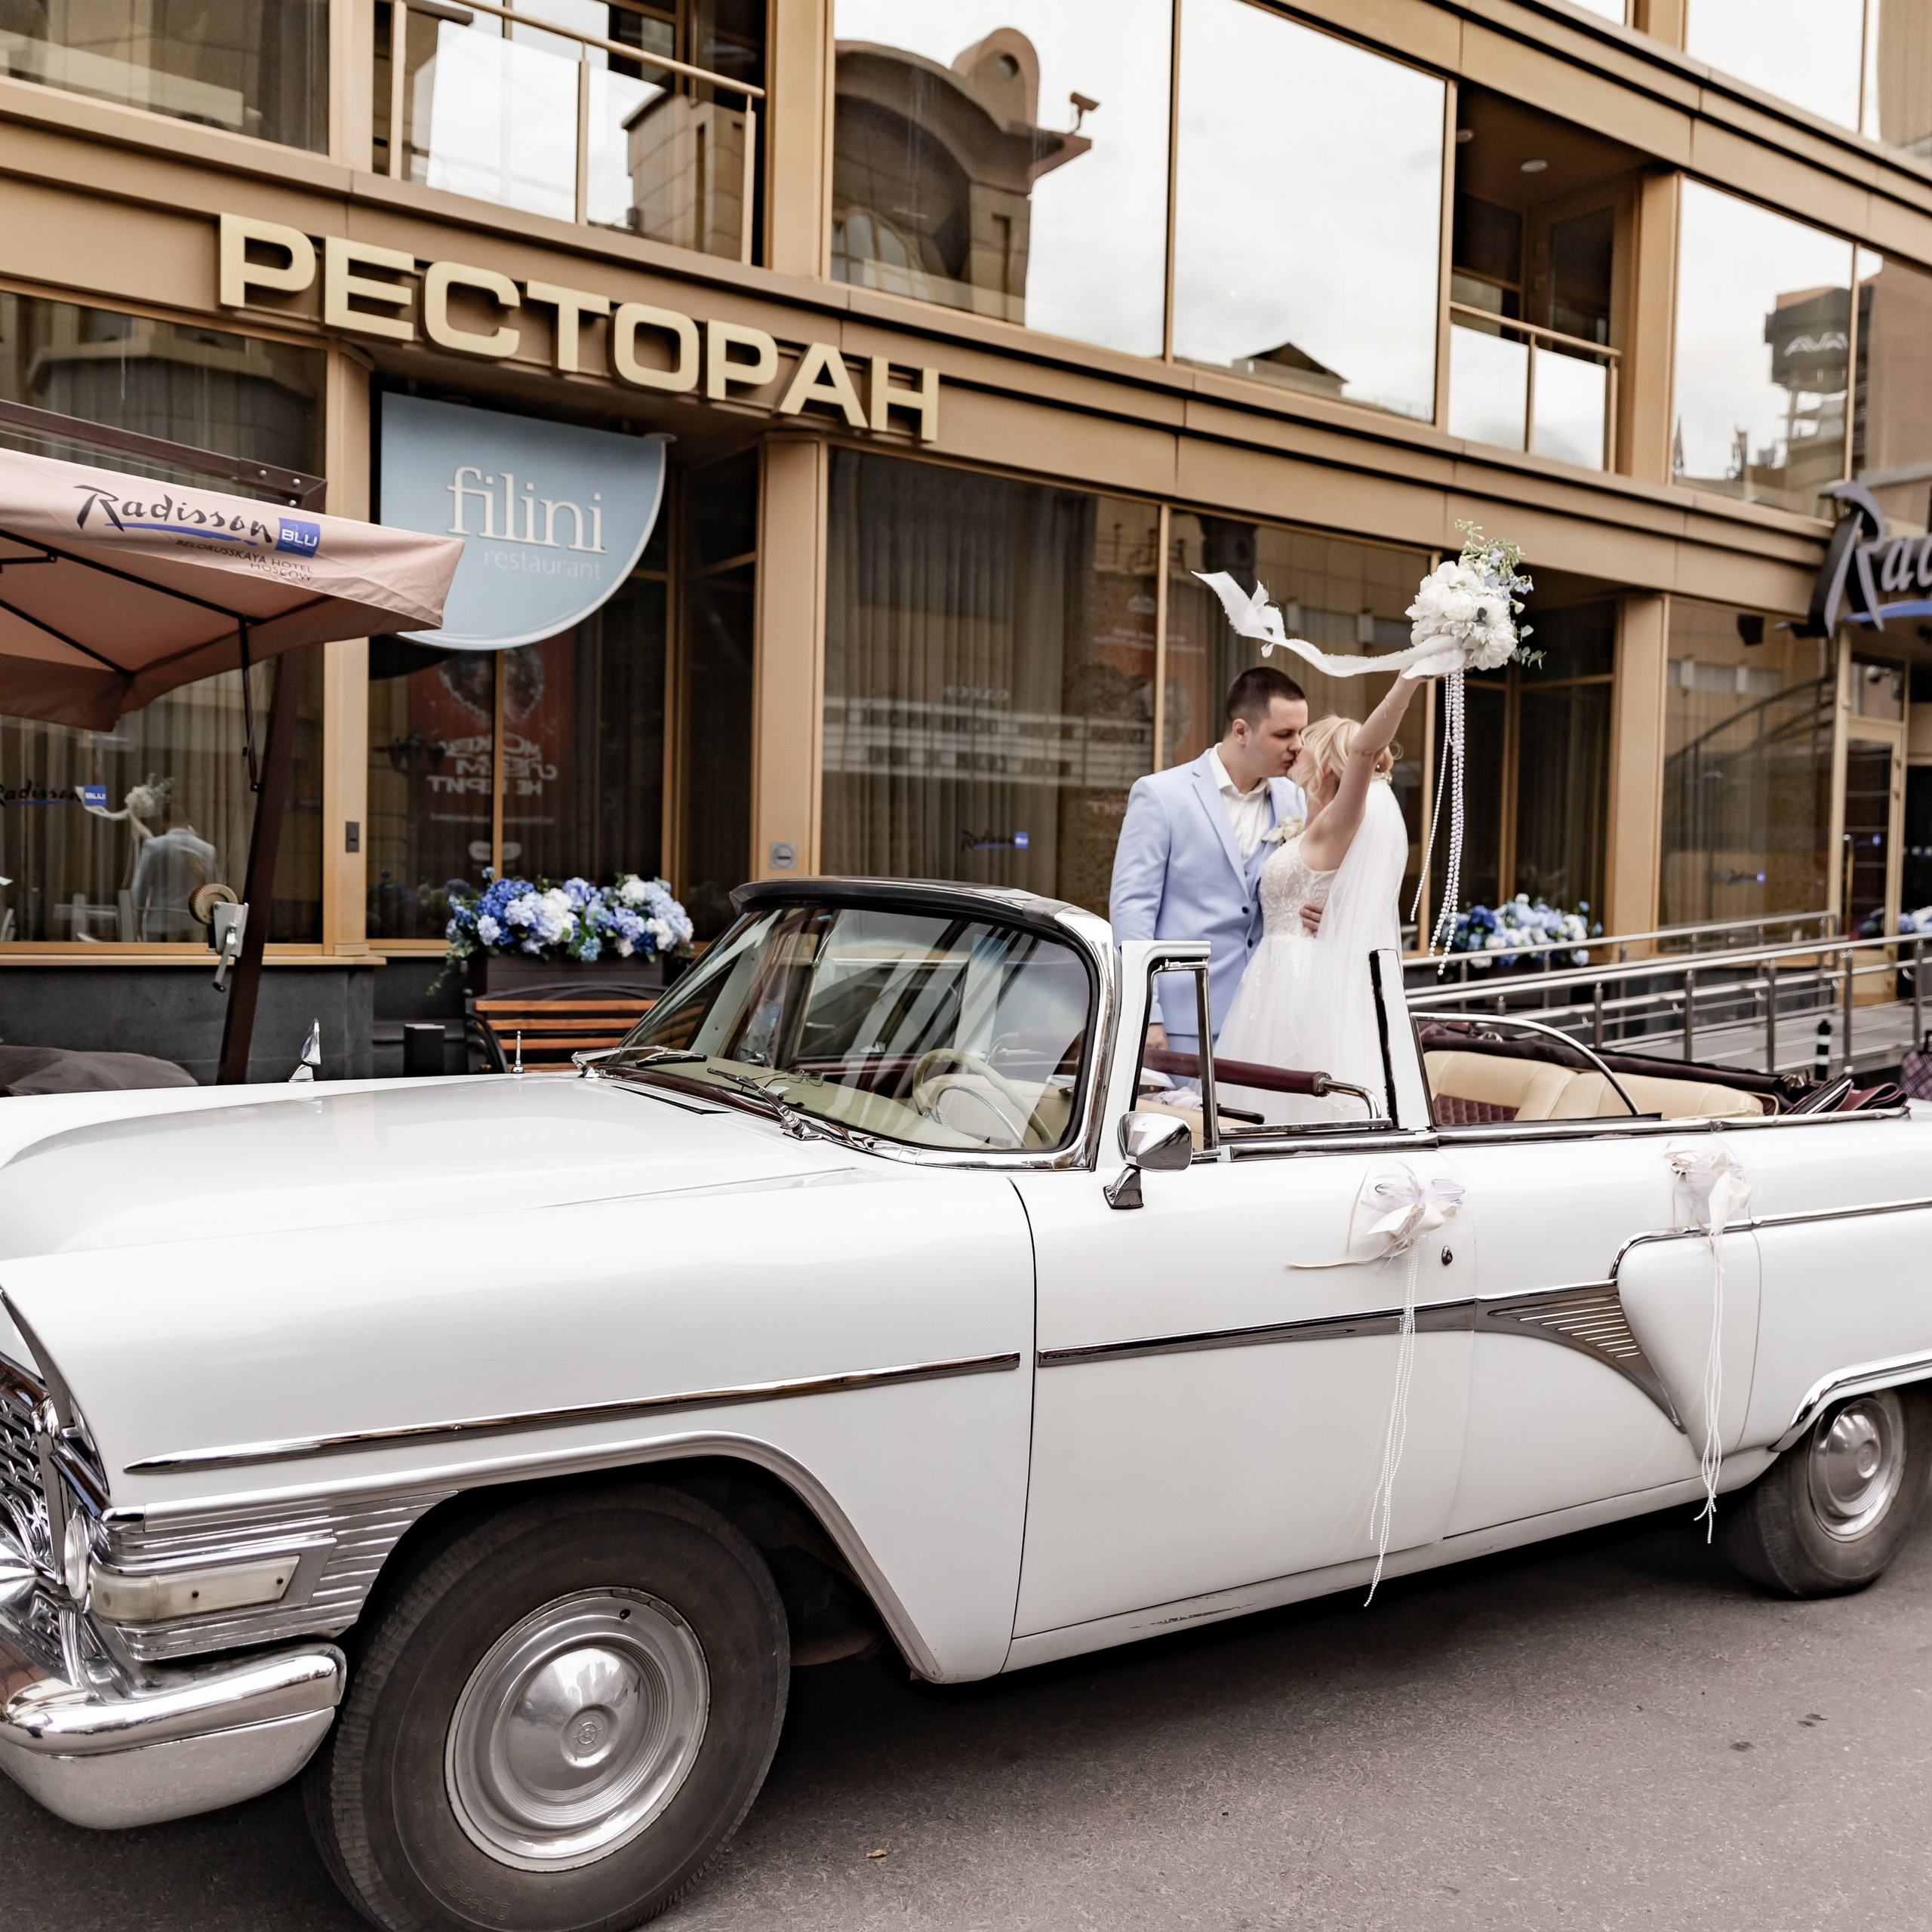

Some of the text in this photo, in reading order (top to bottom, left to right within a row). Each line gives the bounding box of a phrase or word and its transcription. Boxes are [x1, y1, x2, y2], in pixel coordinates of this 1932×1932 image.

[219, 212, 938, 442] РЕСТОРАН
[73, 485, 318, 546] Radisson BLU
[446, 466, 608, 555] filini
[176, 540, 313, 574] BELORUSSKAYA HOTEL
[251, 563, 312, 581] MOSCOW
[485, 550, 601, 581] restaurant
